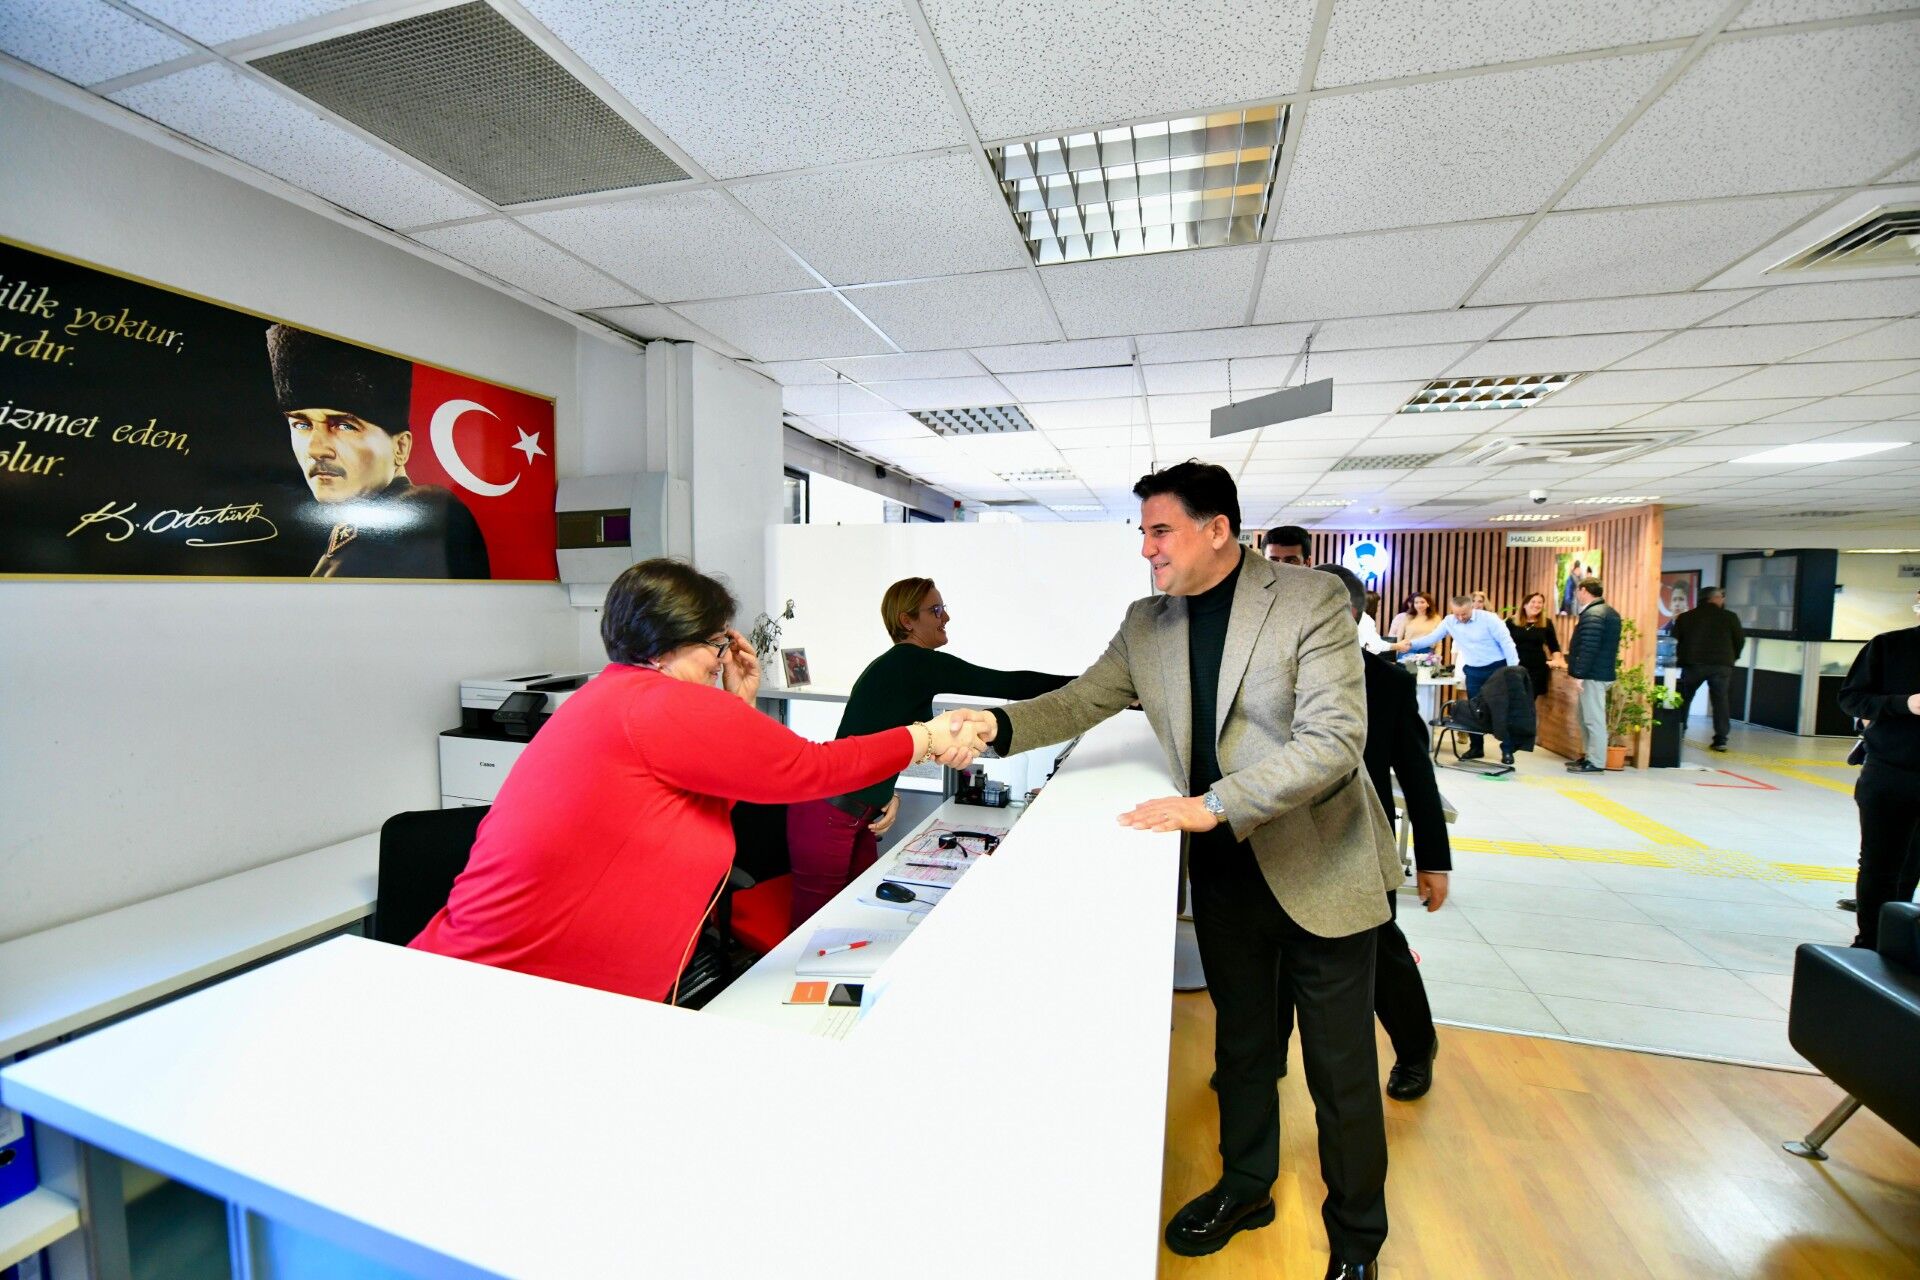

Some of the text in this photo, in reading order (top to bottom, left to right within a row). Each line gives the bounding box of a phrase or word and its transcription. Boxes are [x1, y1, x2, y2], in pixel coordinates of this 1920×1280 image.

[0, 274, 184, 354] ilik yoktur;
[0, 330, 75, 366] rdır.
[112, 418, 190, 456] eden,
